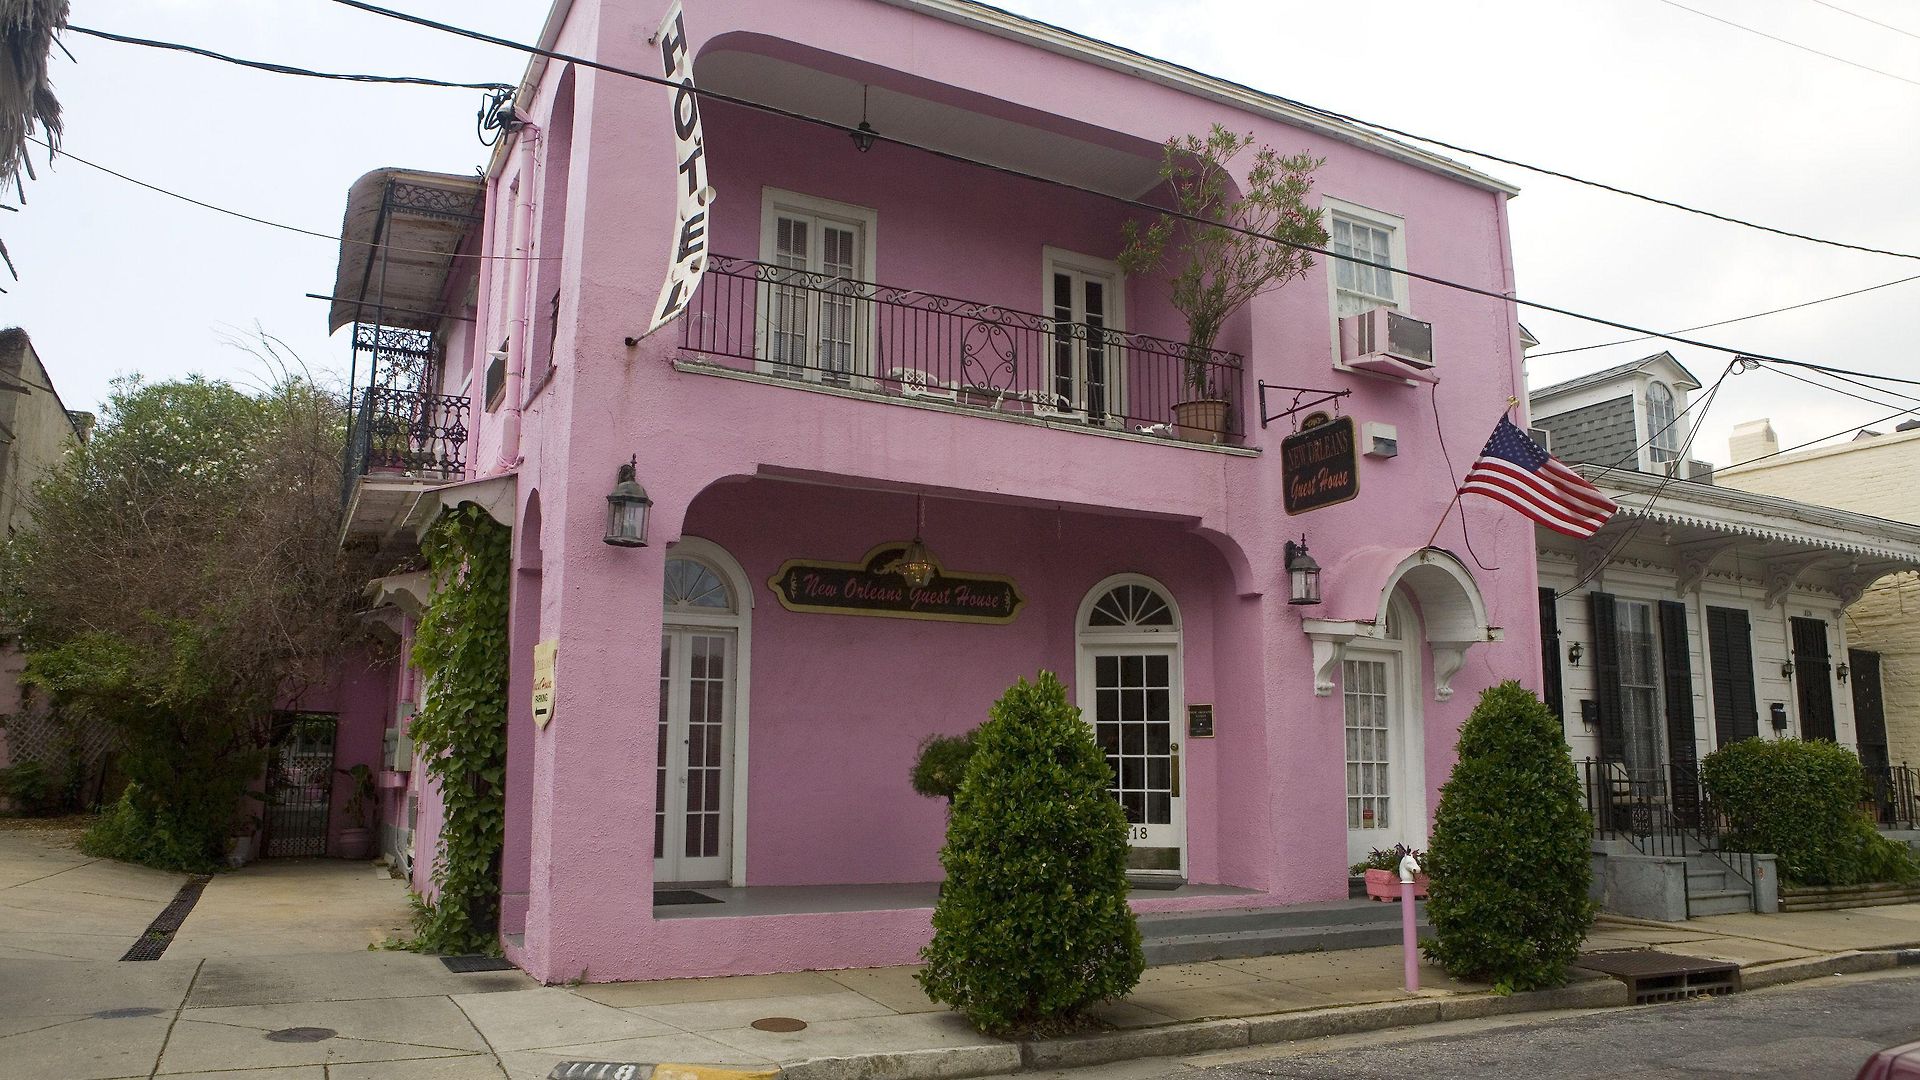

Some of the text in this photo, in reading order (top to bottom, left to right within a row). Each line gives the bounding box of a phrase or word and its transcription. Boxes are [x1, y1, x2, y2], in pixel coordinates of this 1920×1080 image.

[660, 10, 704, 320] HOTEL
[1287, 431, 1348, 470] NEW ORLEANS
[1291, 466, 1349, 508] Guest House
[803, 574, 1000, 609] New Orleans Guest House
[1128, 826, 1148, 840] 18
[566, 1063, 636, 1080] 1118
